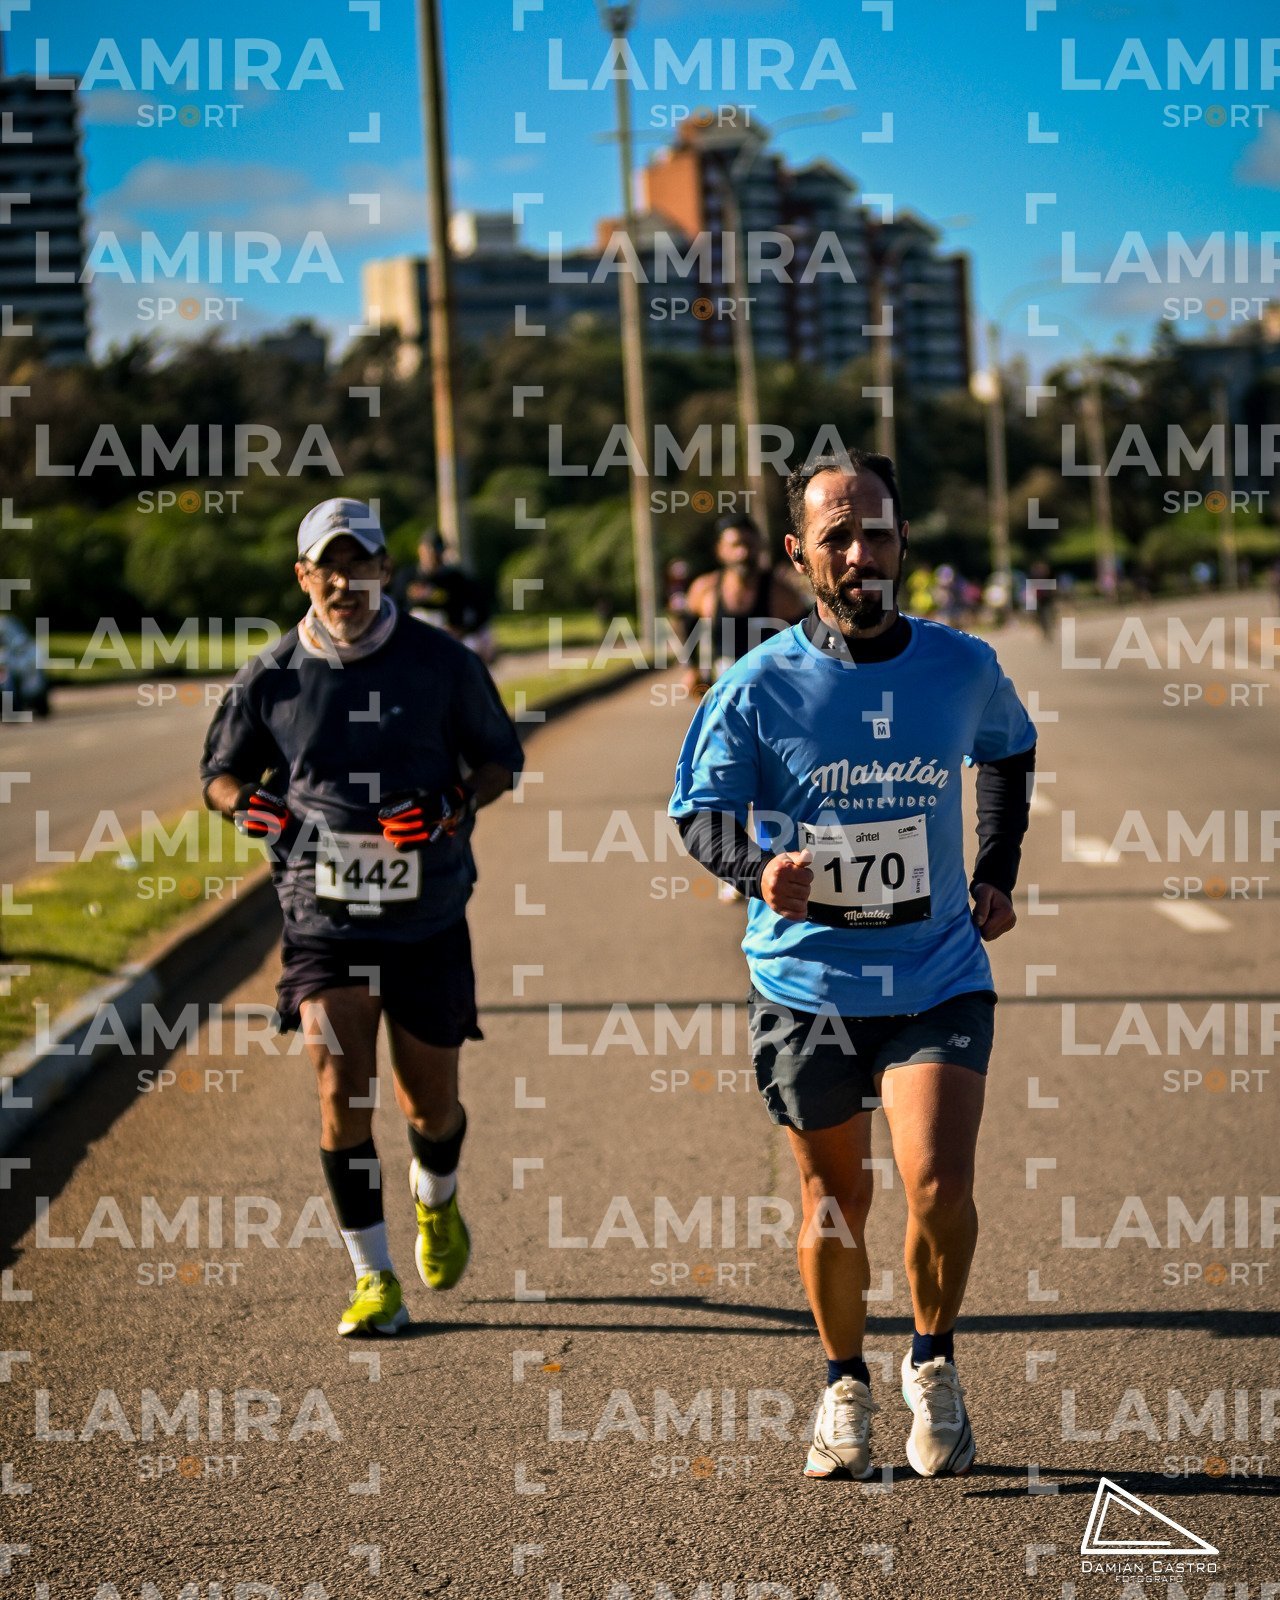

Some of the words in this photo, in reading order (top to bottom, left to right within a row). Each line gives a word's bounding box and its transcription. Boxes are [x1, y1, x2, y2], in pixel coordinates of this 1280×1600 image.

[810, 756, 949, 795] Maratón
[823, 795, 937, 810] MONTEVIDEO
[856, 832, 880, 843] antel
[324, 857, 409, 890] 1442
[823, 852, 906, 893] 170
[843, 909, 891, 921] Maratón
